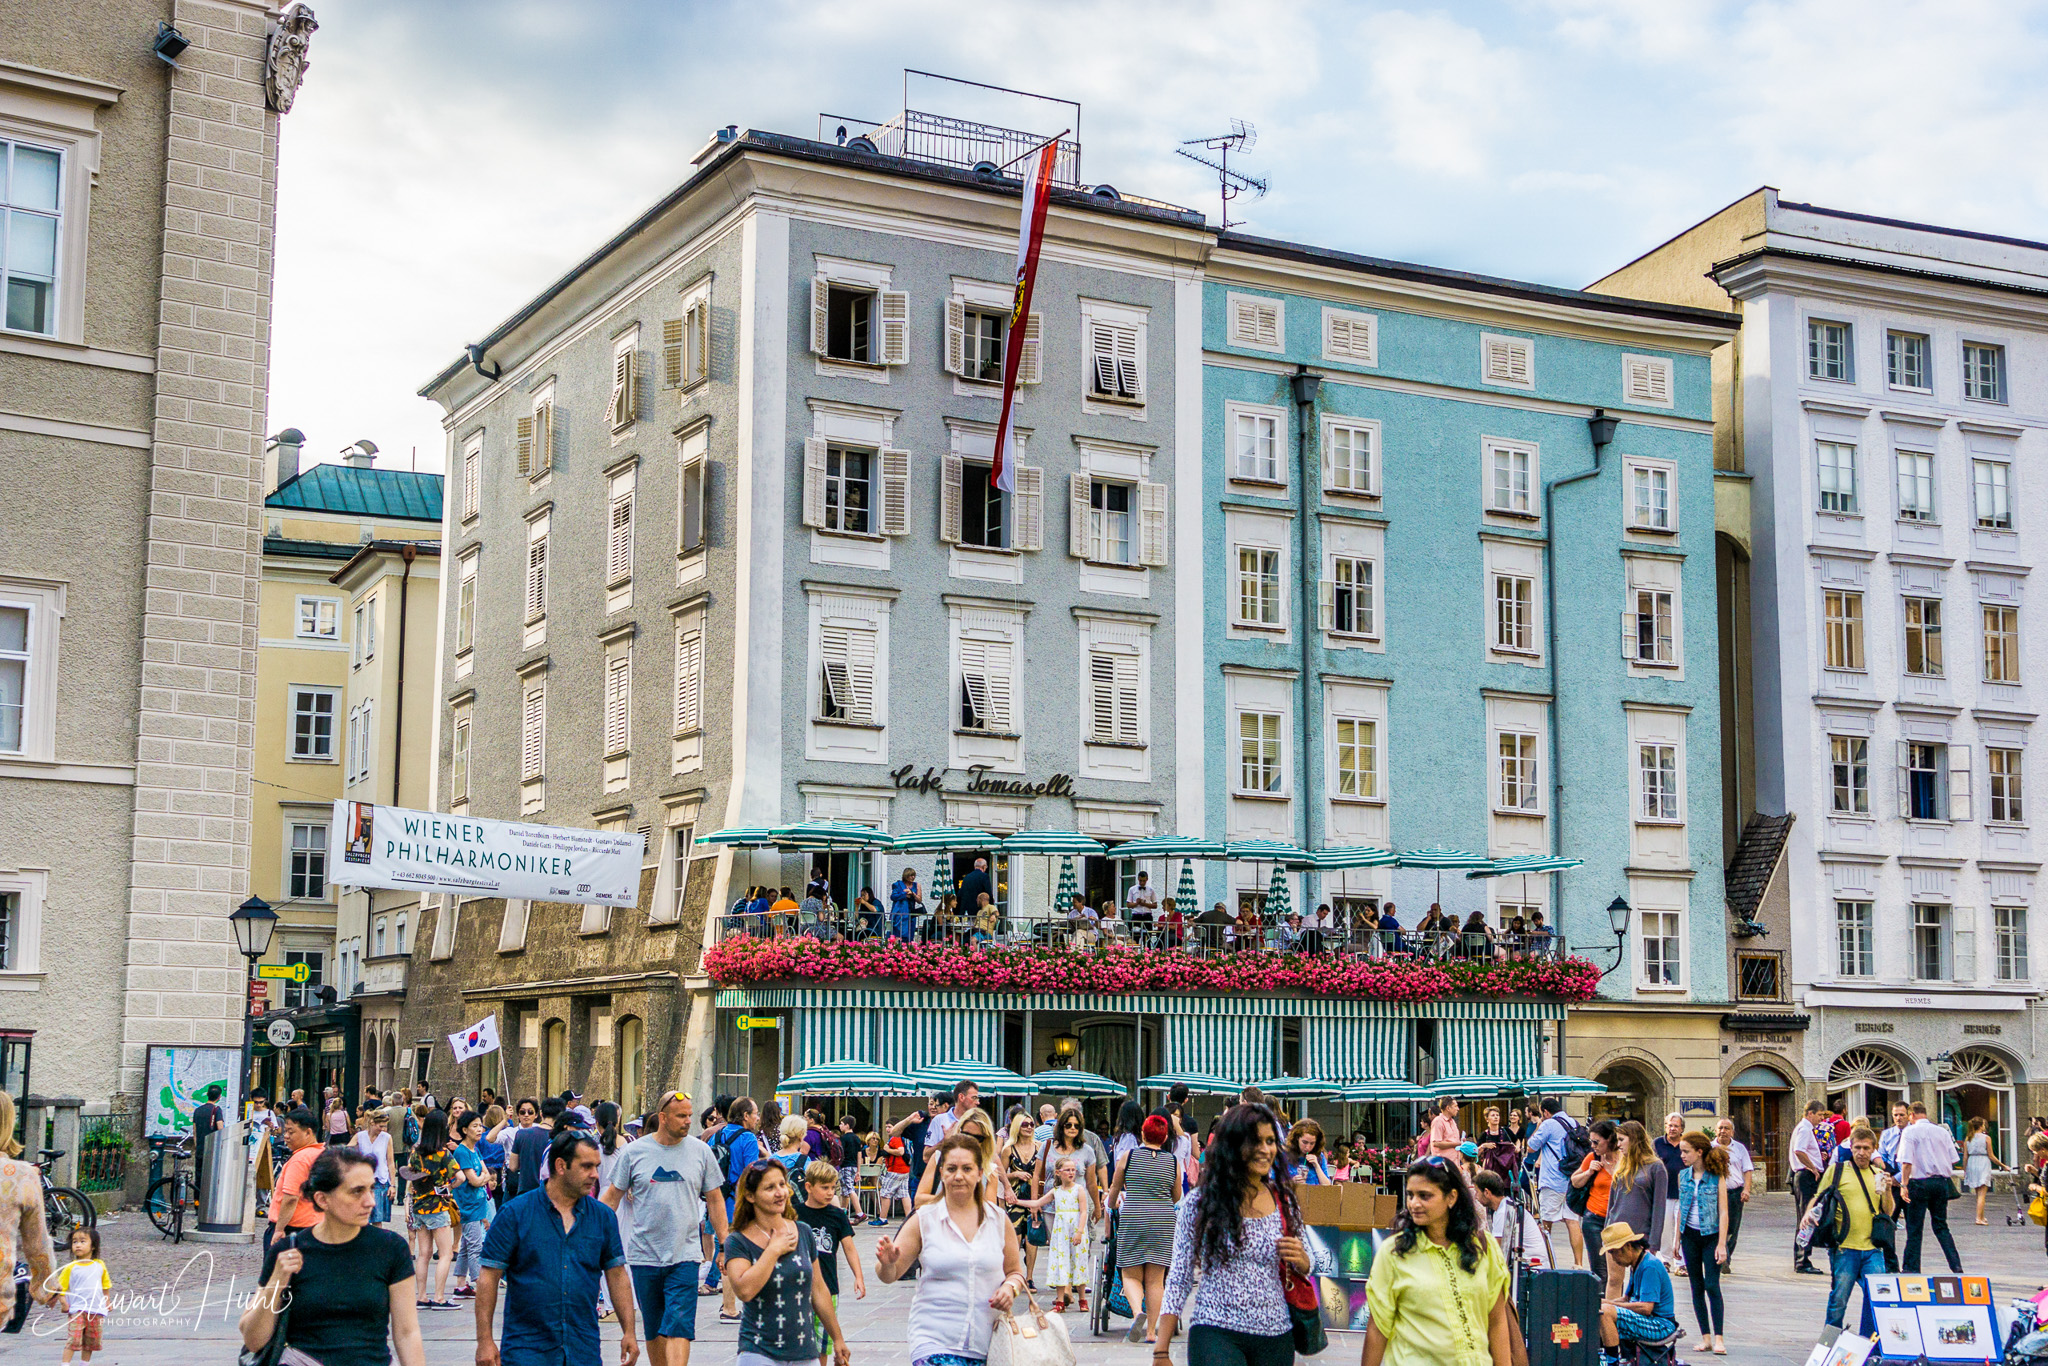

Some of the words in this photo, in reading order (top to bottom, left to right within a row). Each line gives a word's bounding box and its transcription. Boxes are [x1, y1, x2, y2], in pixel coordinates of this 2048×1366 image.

[890, 764, 948, 795] Café
[967, 764, 1077, 797] Tomaselli
[404, 817, 485, 844] WIENER
[386, 840, 572, 876] PHILHARMONIKER
[294, 966, 306, 979] H
[1904, 997, 1932, 1005] HERMÈS
[740, 1017, 749, 1028] H
[1854, 1022, 1895, 1033] HERMÈS
[1963, 1024, 2002, 1035] HERMÈS
[1681, 1100, 1716, 1114] VILEBREQUIN
